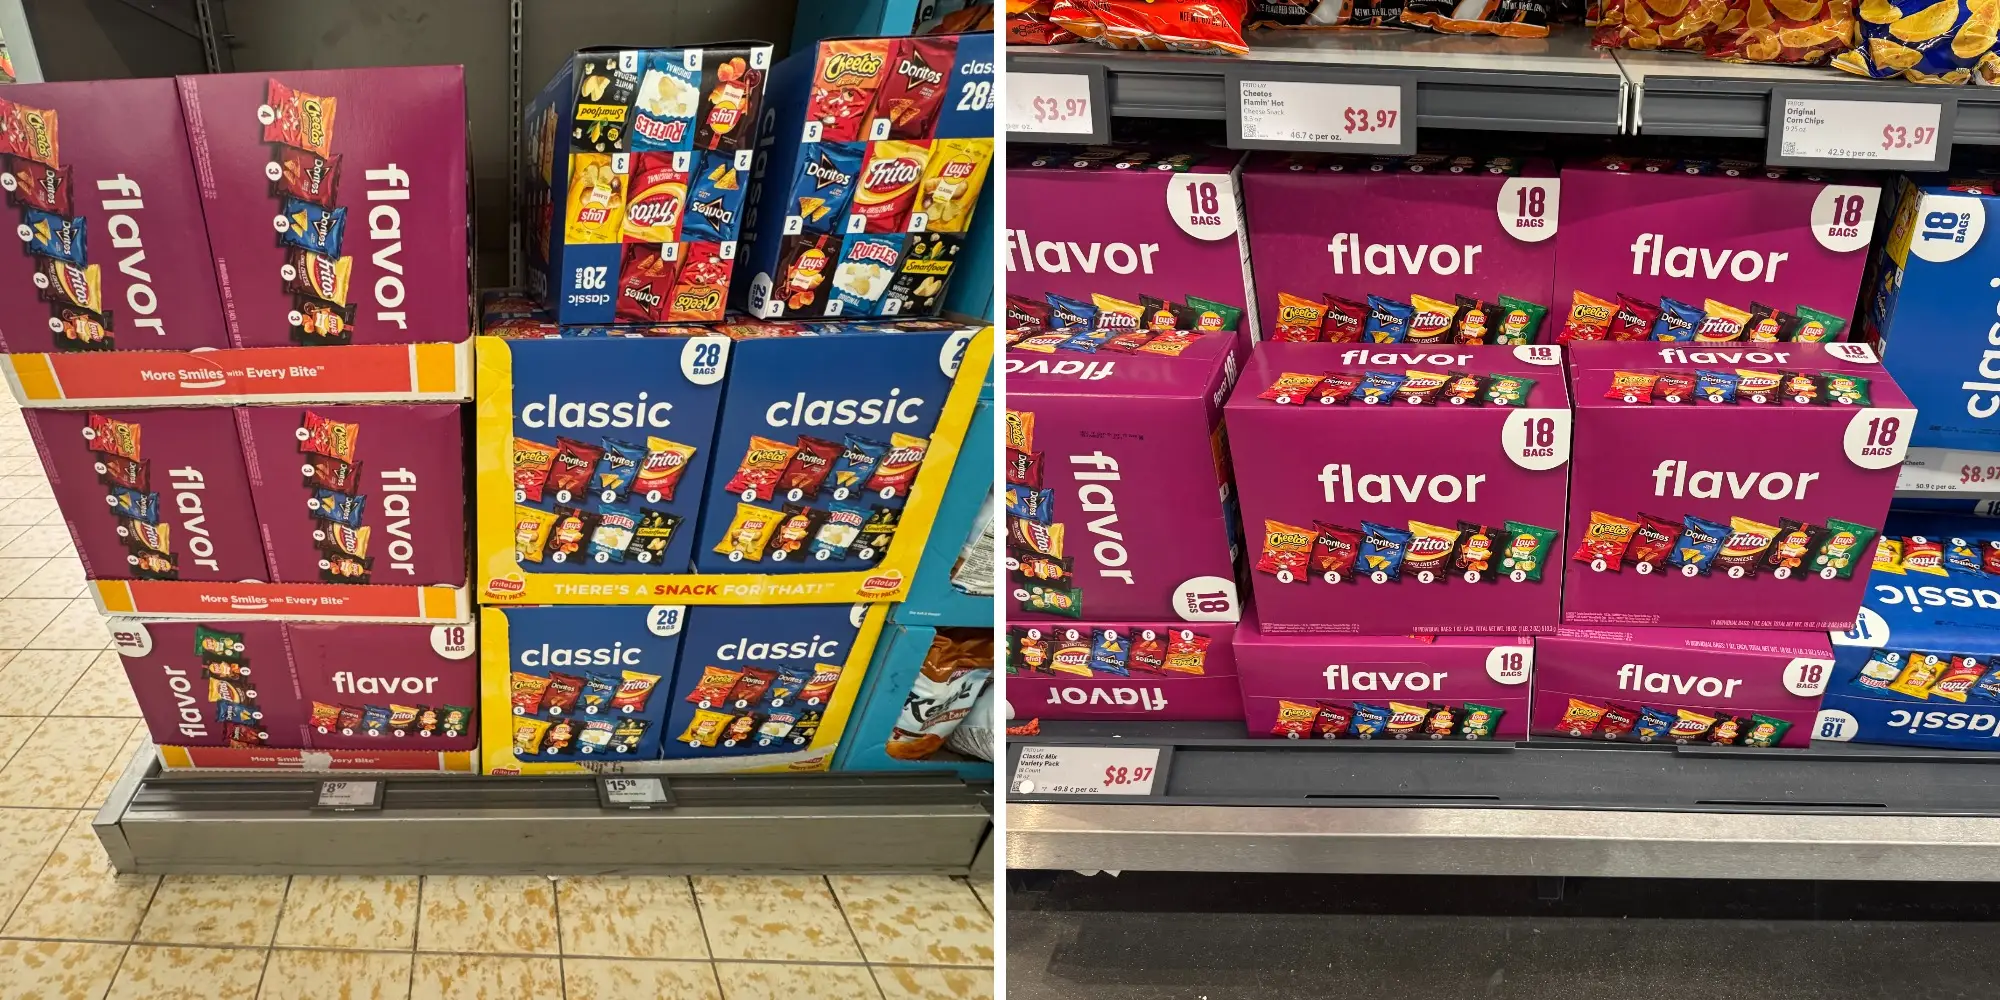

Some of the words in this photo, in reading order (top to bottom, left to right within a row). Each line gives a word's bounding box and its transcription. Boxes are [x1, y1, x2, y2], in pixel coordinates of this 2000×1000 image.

[825, 53, 881, 82] Cheetos
[957, 82, 987, 111] 28
[580, 107, 624, 119] Smartfood
[1033, 96, 1087, 123] $3.97
[1344, 107, 1397, 134] $3.97
[1787, 108, 1815, 116] Original
[635, 116, 686, 142] RUFFLES
[1881, 124, 1935, 150] $3.97
[864, 160, 922, 189] Fritos
[740, 106, 775, 267] classic
[1186, 182, 1219, 214] 18
[1516, 186, 1546, 218] 18
[628, 200, 679, 226] Fritos
[1191, 216, 1221, 226] BAGS
[1833, 194, 1865, 227] 18
[854, 218, 860, 229] 4
[1516, 218, 1544, 228] BAGS
[1828, 226, 1858, 238] BAGS
[1922, 211, 1959, 242] 18
[1955, 212, 1971, 243] BAGS
[97, 173, 166, 336] flavor
[365, 163, 410, 329] flavor
[850, 242, 898, 265] RUFFLES
[1006, 229, 1159, 275] flavor
[1327, 233, 1483, 276] flavor
[906, 261, 949, 272] Smartfood
[1630, 232, 1789, 283] flavor
[583, 266, 607, 289] 28
[568, 294, 610, 306] classic
[676, 292, 720, 311] Cheetos
[1008, 310, 1040, 325] Doritos
[1282, 306, 1318, 321] Cheetos
[1328, 311, 1358, 325] Doritos
[1411, 314, 1450, 328] Fritos
[1574, 305, 1608, 321] Cheetos
[1617, 311, 1647, 328] Doritos
[1700, 319, 1742, 334] Fritos
[693, 343, 720, 367] 28
[1341, 350, 1474, 366] flavor
[1658, 349, 1791, 364] flavor
[141, 370, 176, 381] More
[179, 369, 224, 380] Smiles
[246, 367, 286, 380] Every
[522, 391, 673, 428] classic
[766, 387, 924, 427] classic
[1523, 417, 1555, 448] 18
[1866, 416, 1900, 447] 18
[645, 451, 683, 469] Fritos
[748, 450, 787, 464] Cheetos
[842, 450, 874, 465] Doritos
[1523, 448, 1554, 458] BAGS
[1861, 447, 1893, 457] BAGS
[1317, 463, 1486, 503] flavor
[1652, 460, 1819, 501] flavor
[1960, 464, 2000, 484] $8.97
[168, 465, 219, 571] flavor
[380, 467, 417, 576] flavor
[1070, 450, 1135, 585] flavor
[1269, 532, 1308, 547] Cheetos
[1591, 523, 1630, 538] Cheetos
[1684, 528, 1718, 544] Doritos
[1727, 532, 1771, 549] Fritos
[1411, 536, 1451, 552] Fritos
[1329, 573, 1336, 582] 3
[1515, 572, 1521, 581] 3
[201, 594, 228, 603] More
[230, 595, 267, 604] Smiles
[286, 596, 317, 607] Every
[554, 584, 630, 596] THERE'S
[635, 584, 648, 595] A
[654, 584, 718, 595] SNACK
[723, 583, 760, 596] FOR
[1186, 592, 1198, 614] BAGS
[1197, 591, 1230, 613] 18
[657, 609, 678, 626] 28
[444, 627, 465, 646] 18
[521, 642, 642, 666] classic
[717, 635, 839, 661] classic
[1500, 653, 1523, 671] 18
[332, 671, 439, 694] flavor
[1323, 665, 1447, 692] flavor
[1617, 664, 1742, 698] flavor
[1800, 664, 1823, 684] 18
[163, 665, 208, 739] flavor
[1047, 687, 1168, 711] flavor
[1821, 723, 1842, 738] 18
[1103, 765, 1152, 787] $8.97
